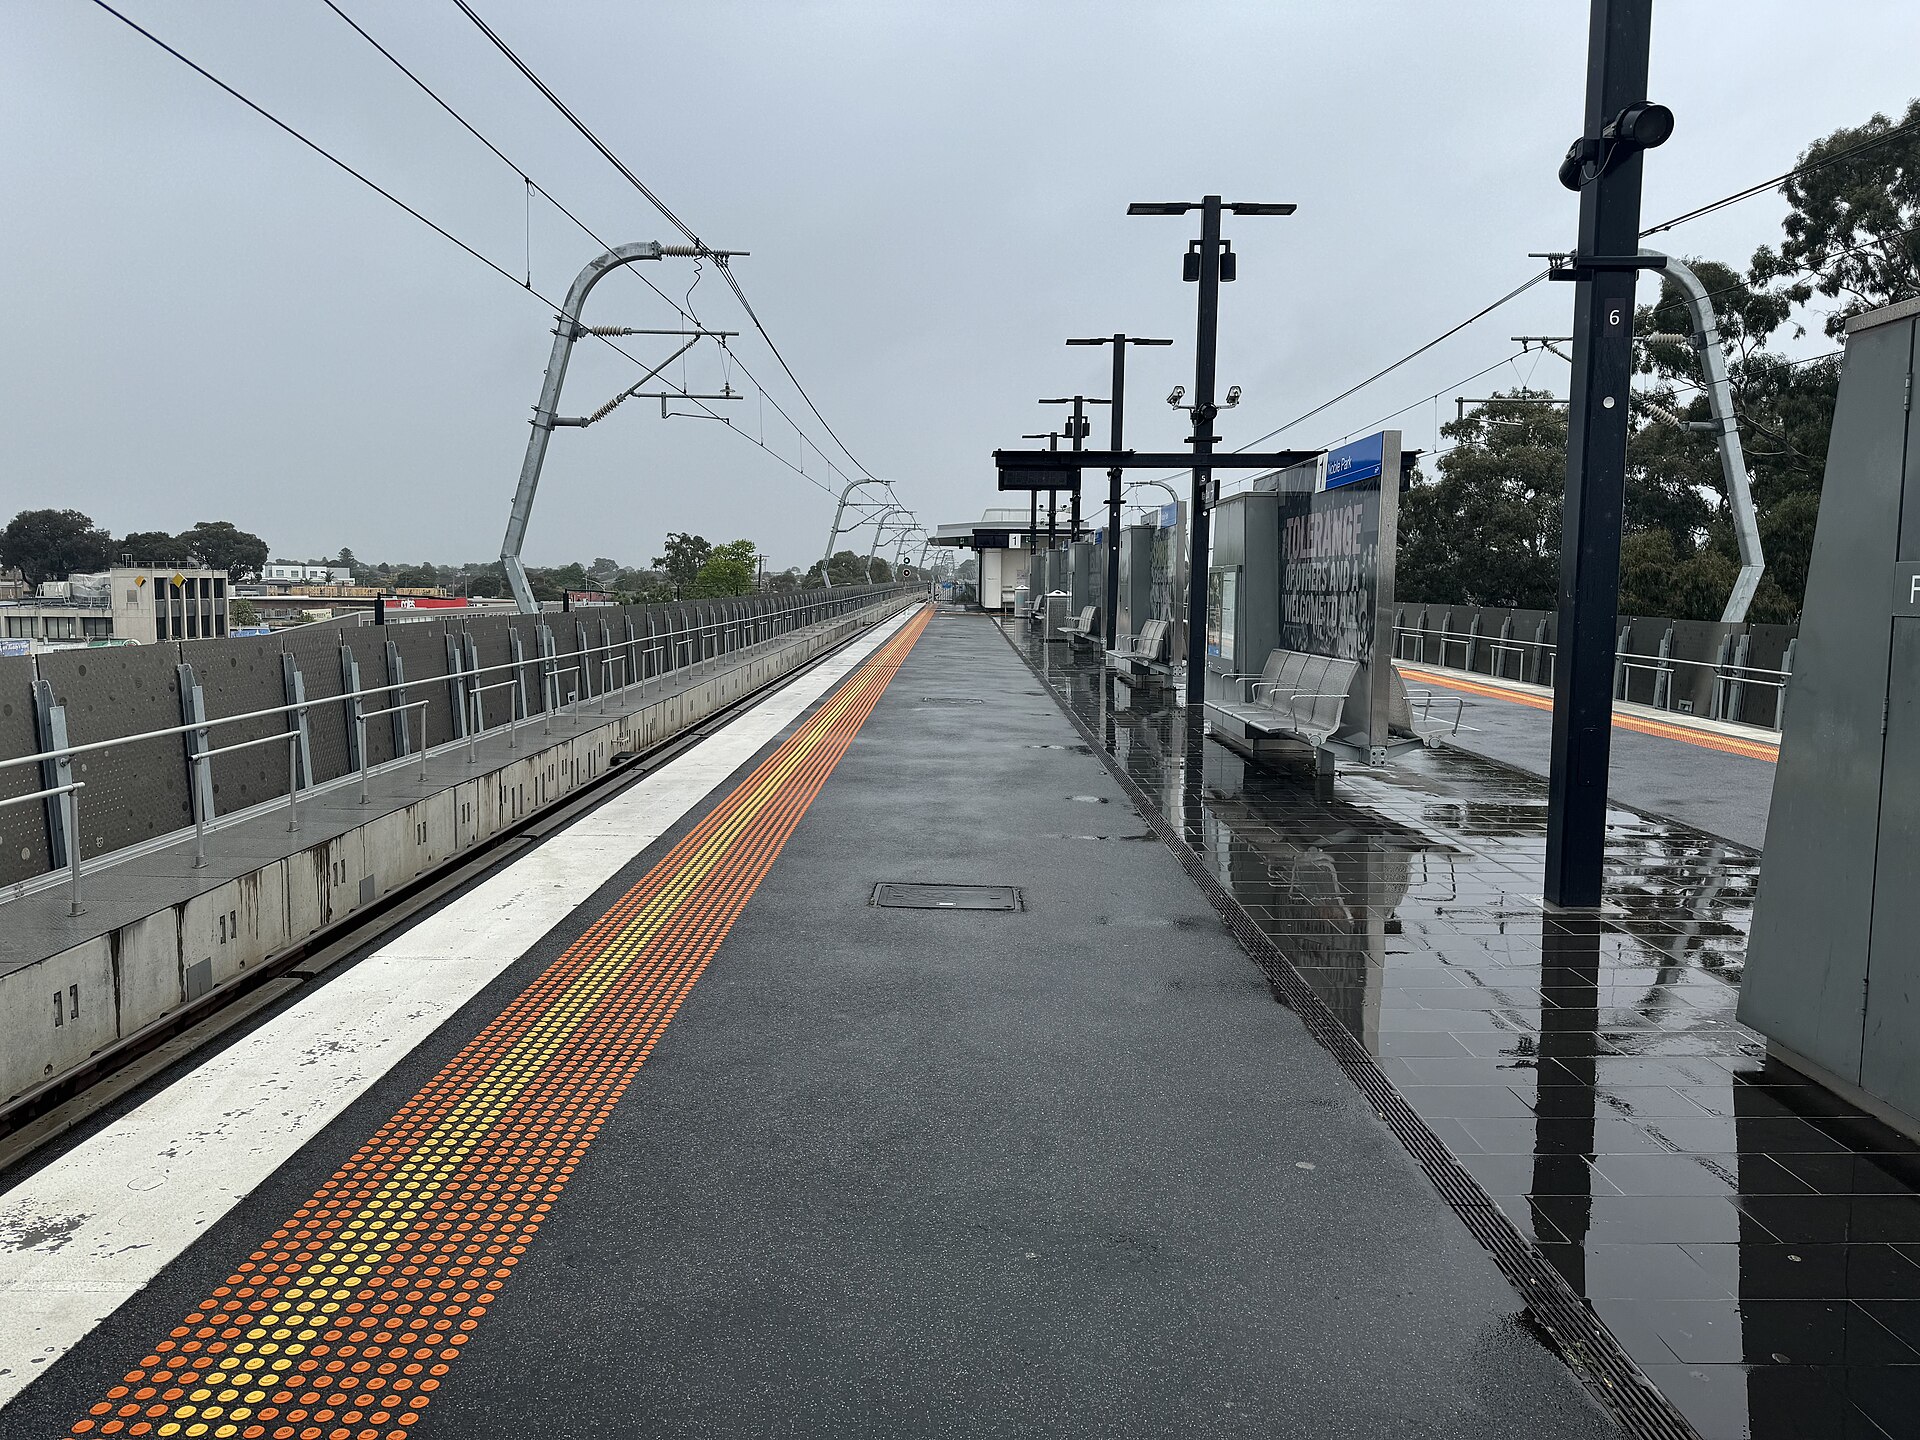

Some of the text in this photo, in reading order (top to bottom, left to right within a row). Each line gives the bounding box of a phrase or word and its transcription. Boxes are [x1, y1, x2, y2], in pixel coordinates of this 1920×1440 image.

[1609, 309, 1620, 325] 6
[1341, 456, 1352, 471] Park
[1012, 536, 1017, 546] 1
[1329, 560, 1350, 591] AND
[1351, 559, 1359, 592] A
